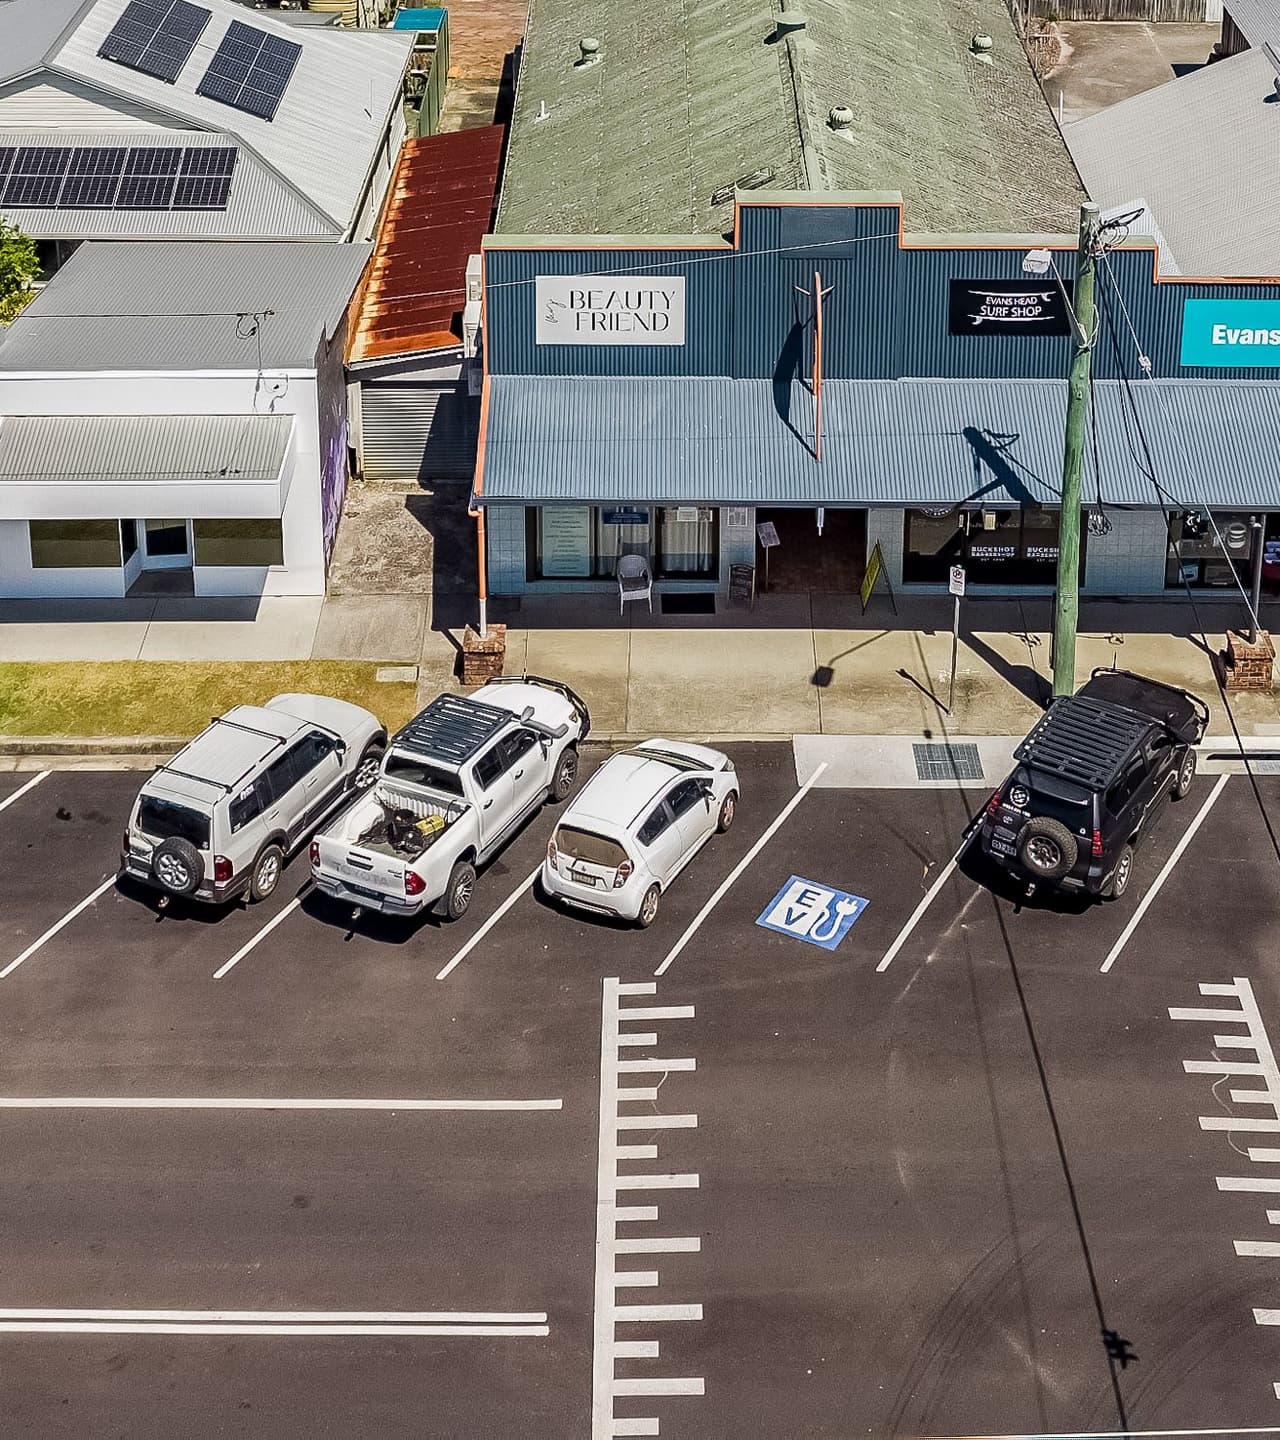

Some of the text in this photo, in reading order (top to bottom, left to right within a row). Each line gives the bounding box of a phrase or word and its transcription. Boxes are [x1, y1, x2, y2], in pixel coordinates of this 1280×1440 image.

[570, 290, 675, 310] BEAUTY
[985, 296, 1038, 305] EVANS HEAD
[980, 305, 1042, 317] SURF SHOP
[576, 312, 669, 331] FRIEND
[331, 861, 391, 886] TOYOTA
[785, 888, 822, 926] EV
